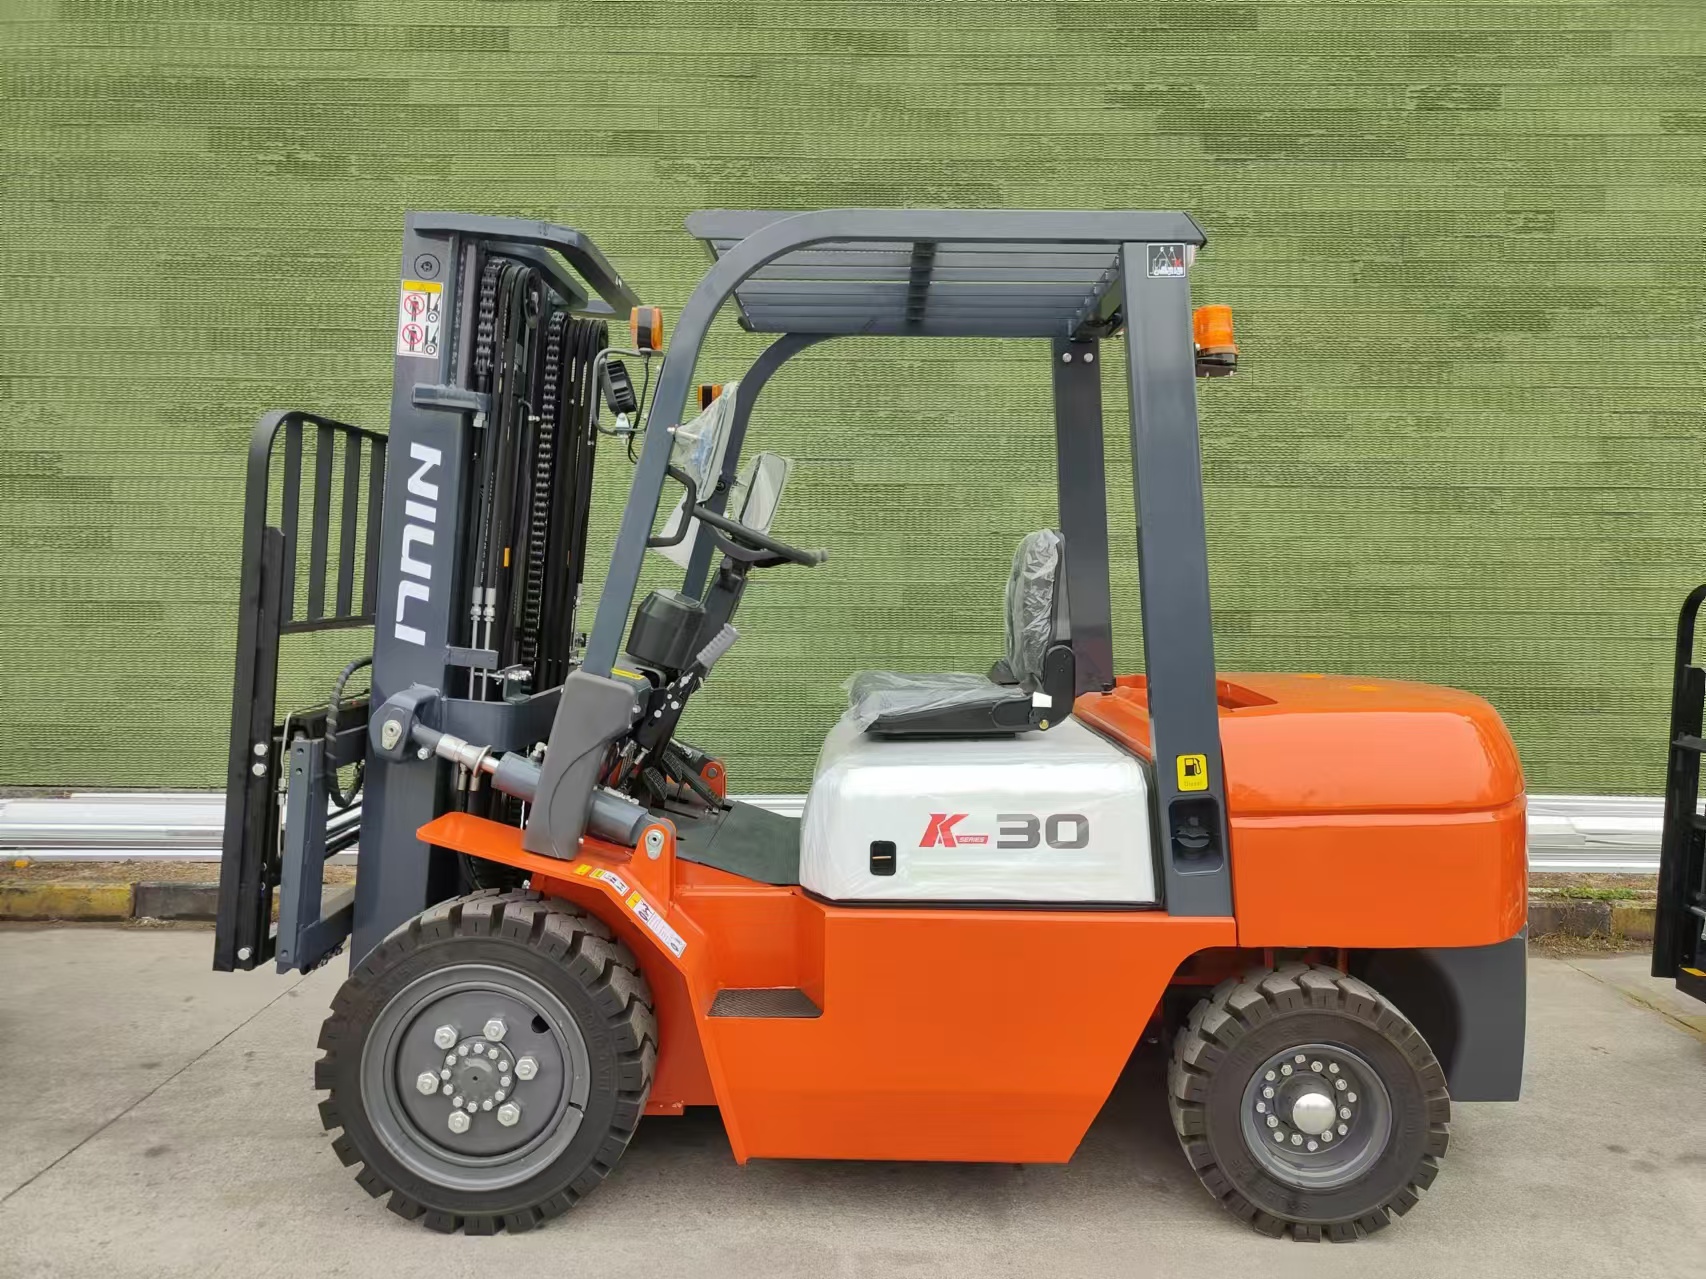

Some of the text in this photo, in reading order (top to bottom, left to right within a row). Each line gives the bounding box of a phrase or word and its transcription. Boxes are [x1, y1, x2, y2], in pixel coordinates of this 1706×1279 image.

[394, 442, 442, 646] NIULI
[919, 813, 1090, 849] K SERIES 30
